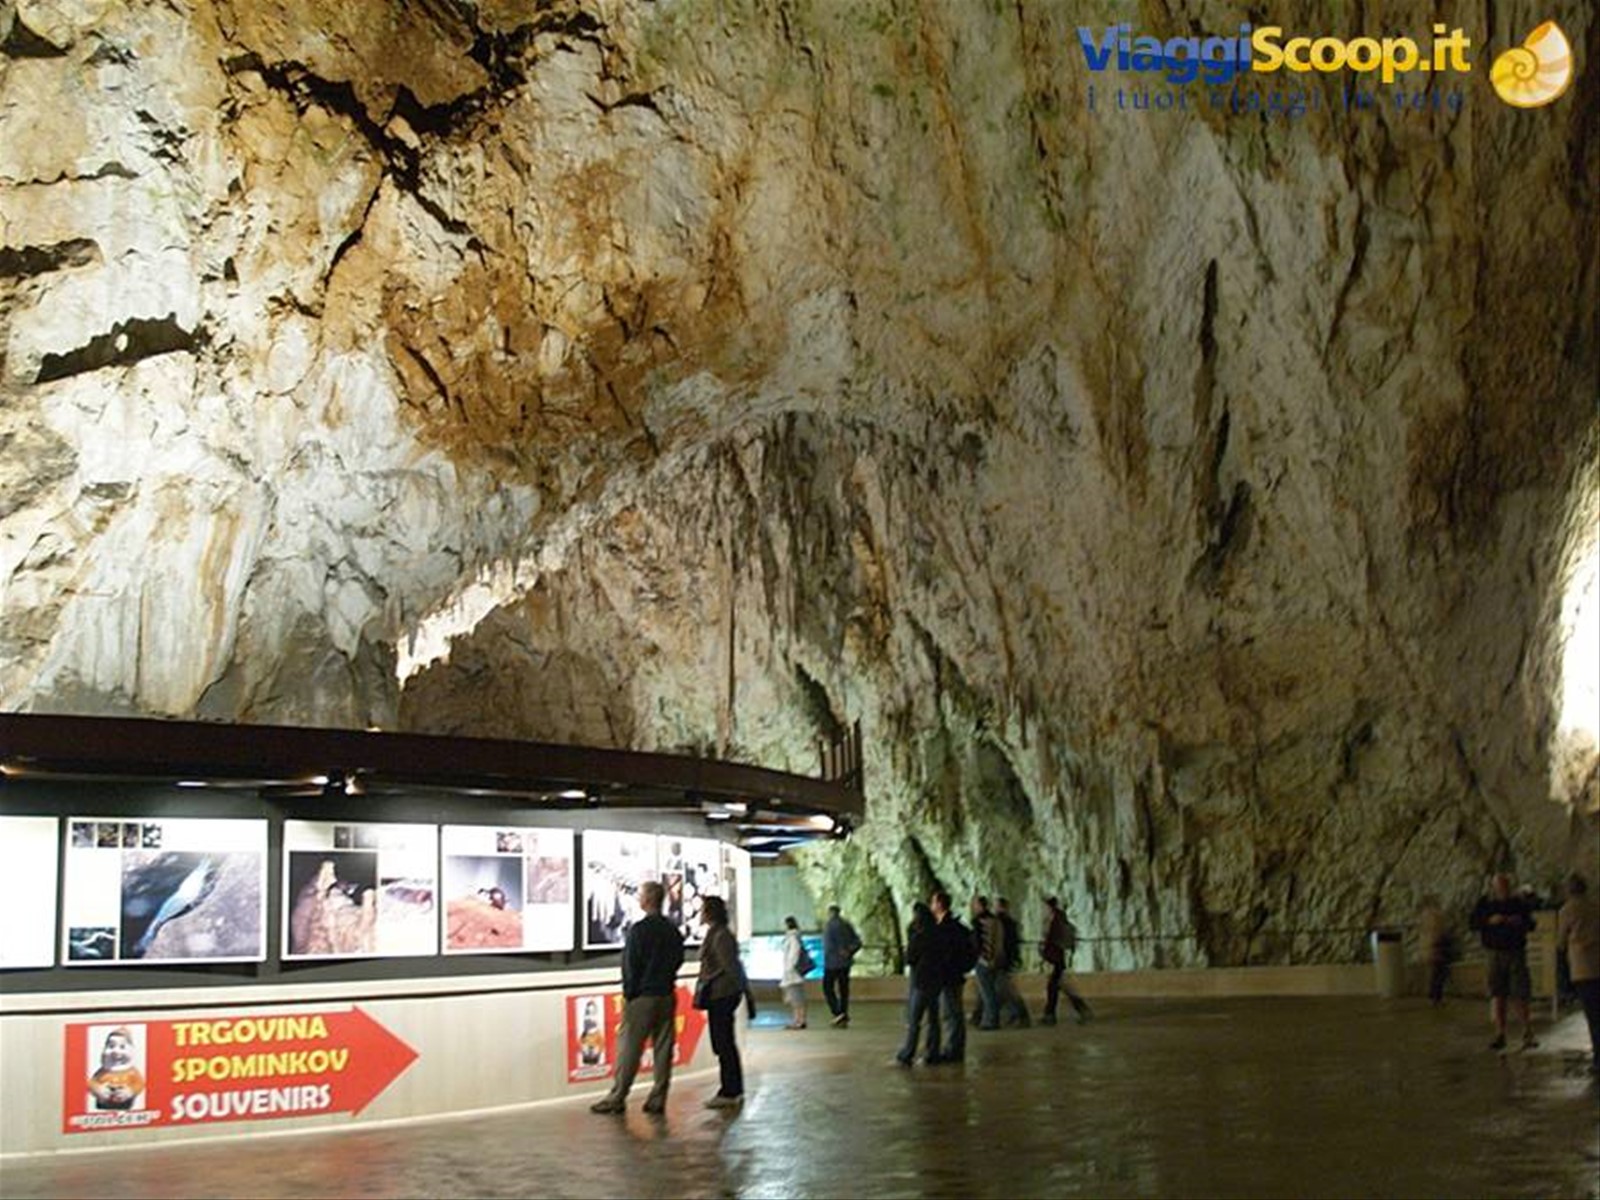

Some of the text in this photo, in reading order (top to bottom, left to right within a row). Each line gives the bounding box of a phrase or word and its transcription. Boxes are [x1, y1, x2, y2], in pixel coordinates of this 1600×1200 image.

[172, 1016, 328, 1047] TRGOVINA
[172, 1048, 349, 1083] SPOMINKOV
[171, 1084, 331, 1121] SOUVENIRS
